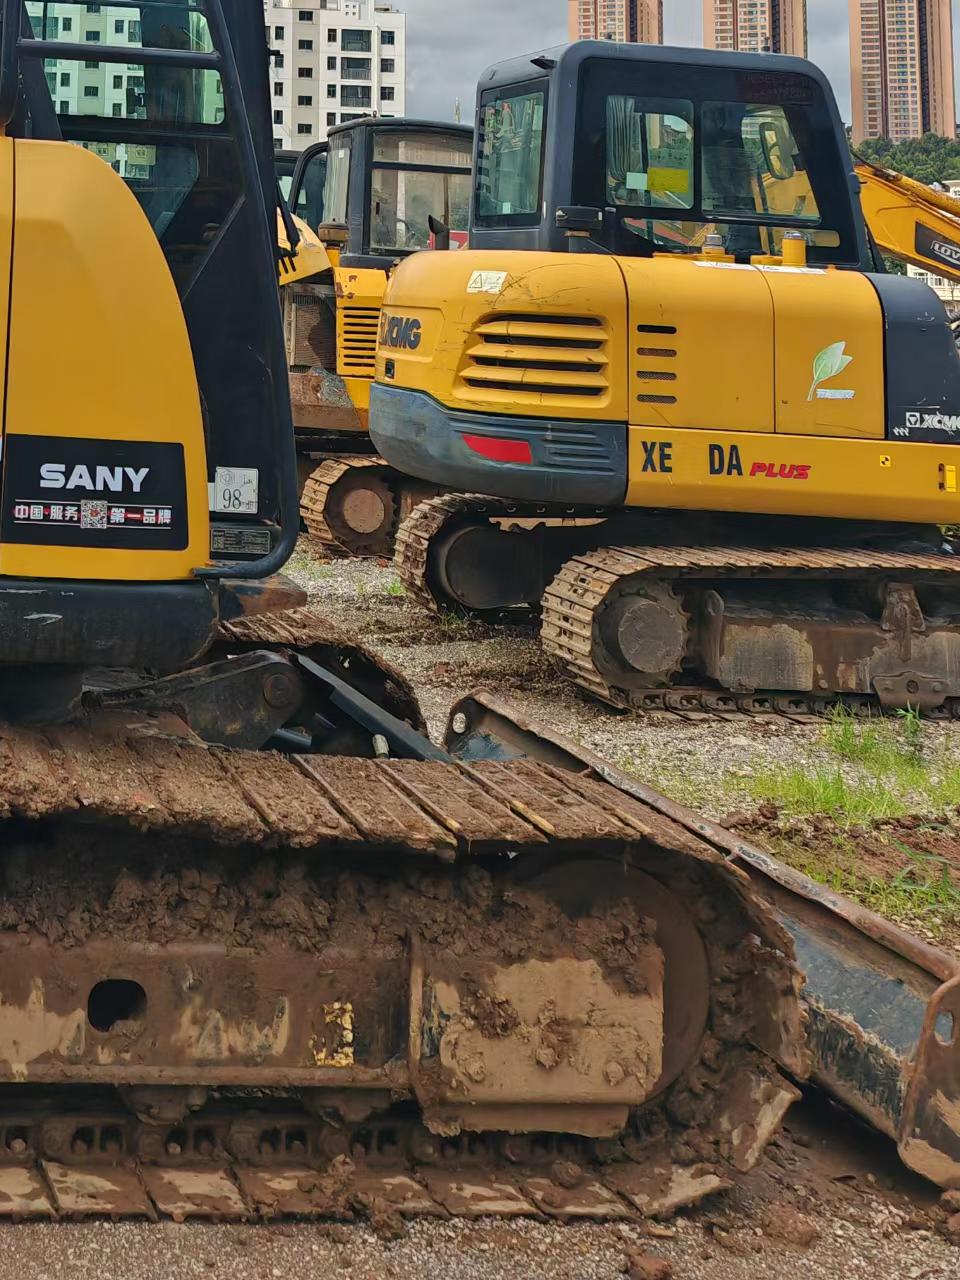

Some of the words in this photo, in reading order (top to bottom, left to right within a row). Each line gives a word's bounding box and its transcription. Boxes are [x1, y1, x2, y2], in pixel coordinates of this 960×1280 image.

[920, 413, 960, 431] XCM
[641, 441, 673, 473] XE
[708, 444, 743, 476] DA
[749, 462, 812, 480] PLUS
[39, 463, 150, 493] SANY
[222, 488, 242, 510] 98
